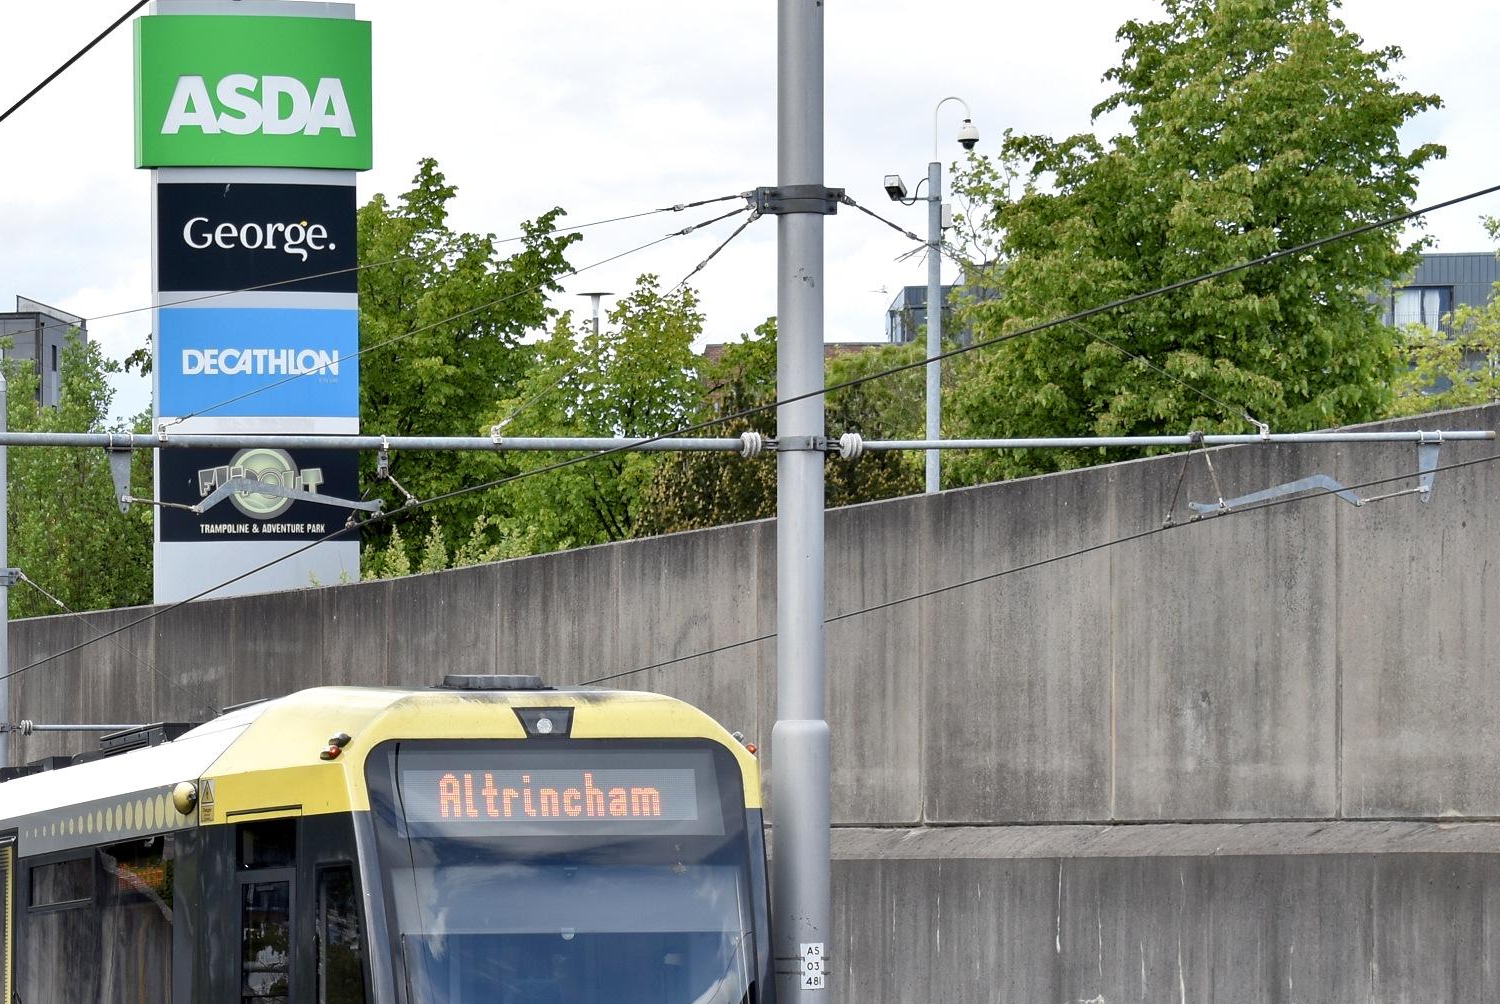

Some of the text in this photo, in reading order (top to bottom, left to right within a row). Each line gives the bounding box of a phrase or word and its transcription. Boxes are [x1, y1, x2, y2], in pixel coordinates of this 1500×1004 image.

[161, 73, 357, 137] ASDA
[183, 217, 336, 262] George.
[182, 348, 339, 376] DECATHLON
[200, 523, 326, 534] TRAMPOLINE & ADVENTURE PARK
[439, 772, 661, 818] Altrincham
[807, 946, 820, 955] AS
[807, 962, 820, 971] 03
